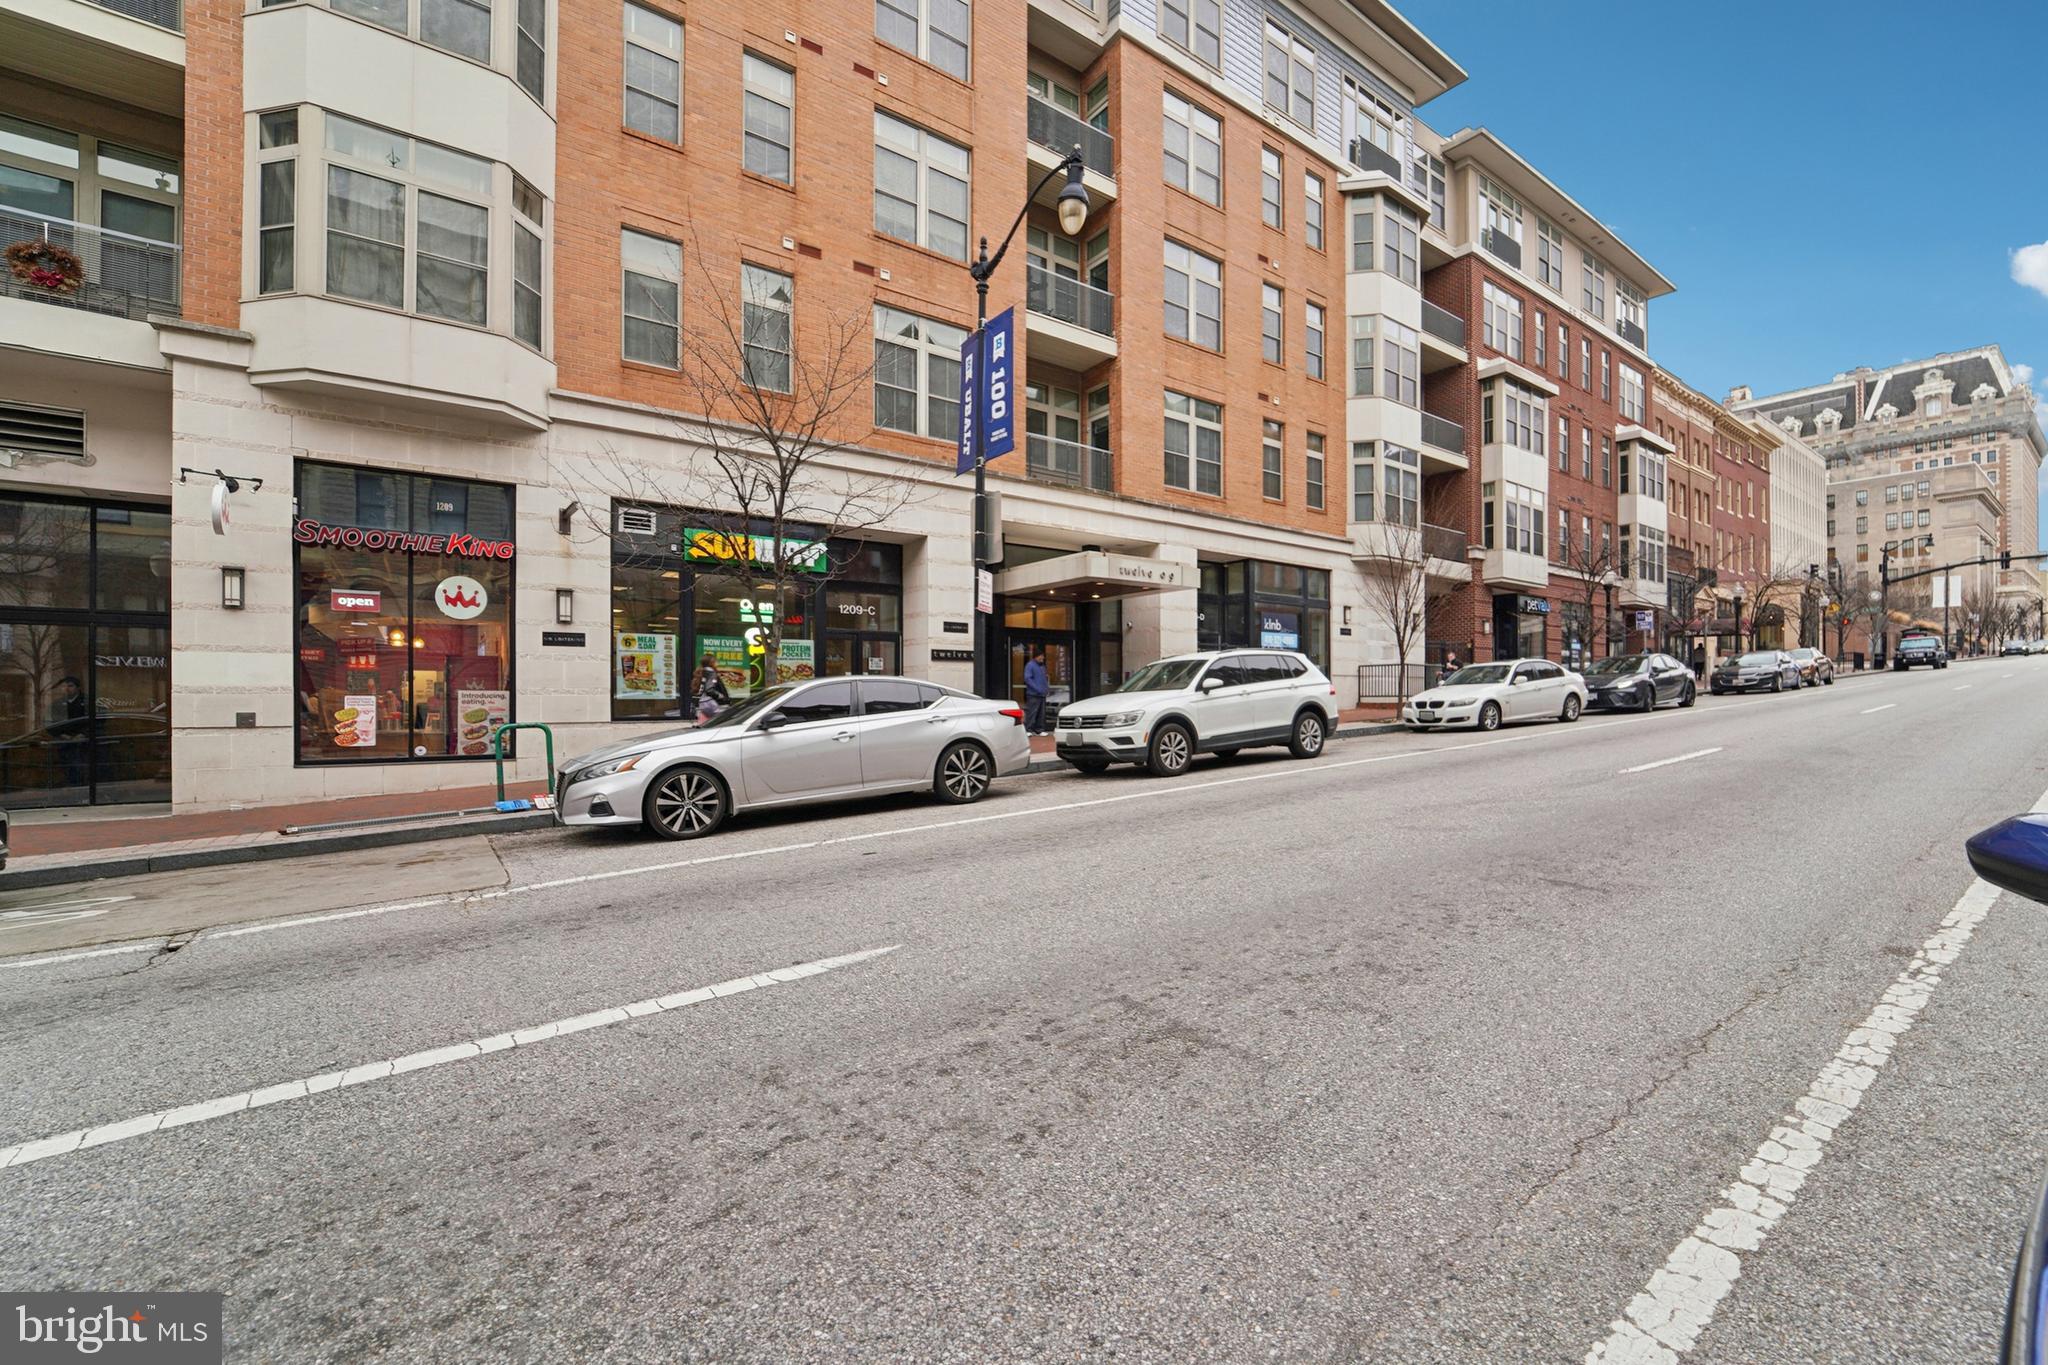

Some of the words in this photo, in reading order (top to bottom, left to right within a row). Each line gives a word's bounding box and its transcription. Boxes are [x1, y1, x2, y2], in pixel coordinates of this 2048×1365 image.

[991, 367, 1006, 419] 100
[436, 502, 454, 513] 1209
[294, 519, 446, 553] SMOOTHIE
[688, 532, 828, 567] SUBWAY
[1119, 566, 1153, 579] twelve
[338, 596, 375, 608] open
[740, 599, 774, 611] Oen
[838, 604, 876, 615] 1209-C
[703, 638, 721, 647] NOW
[781, 644, 811, 652] PROTEIN
[716, 651, 743, 660] FREE
